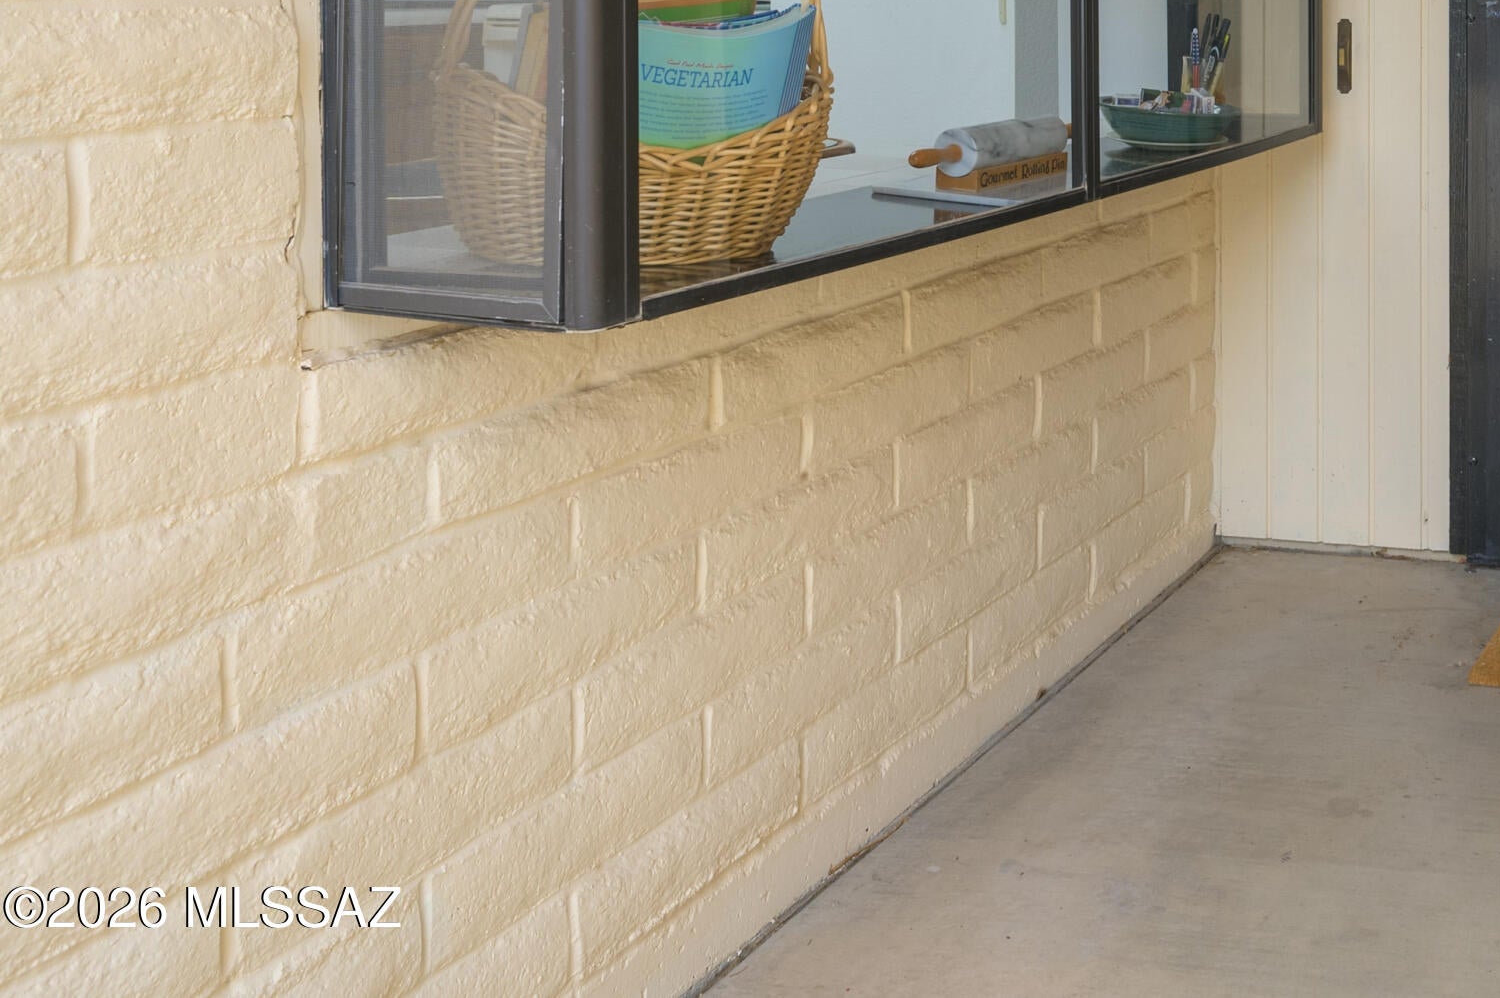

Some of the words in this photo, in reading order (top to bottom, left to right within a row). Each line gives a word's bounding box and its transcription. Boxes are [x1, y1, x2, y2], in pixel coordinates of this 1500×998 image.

[641, 63, 754, 89] VEGETARIAN
[980, 168, 1018, 187] Gourmet
[1021, 160, 1050, 179] Rolling
[1052, 158, 1065, 172] Pin
